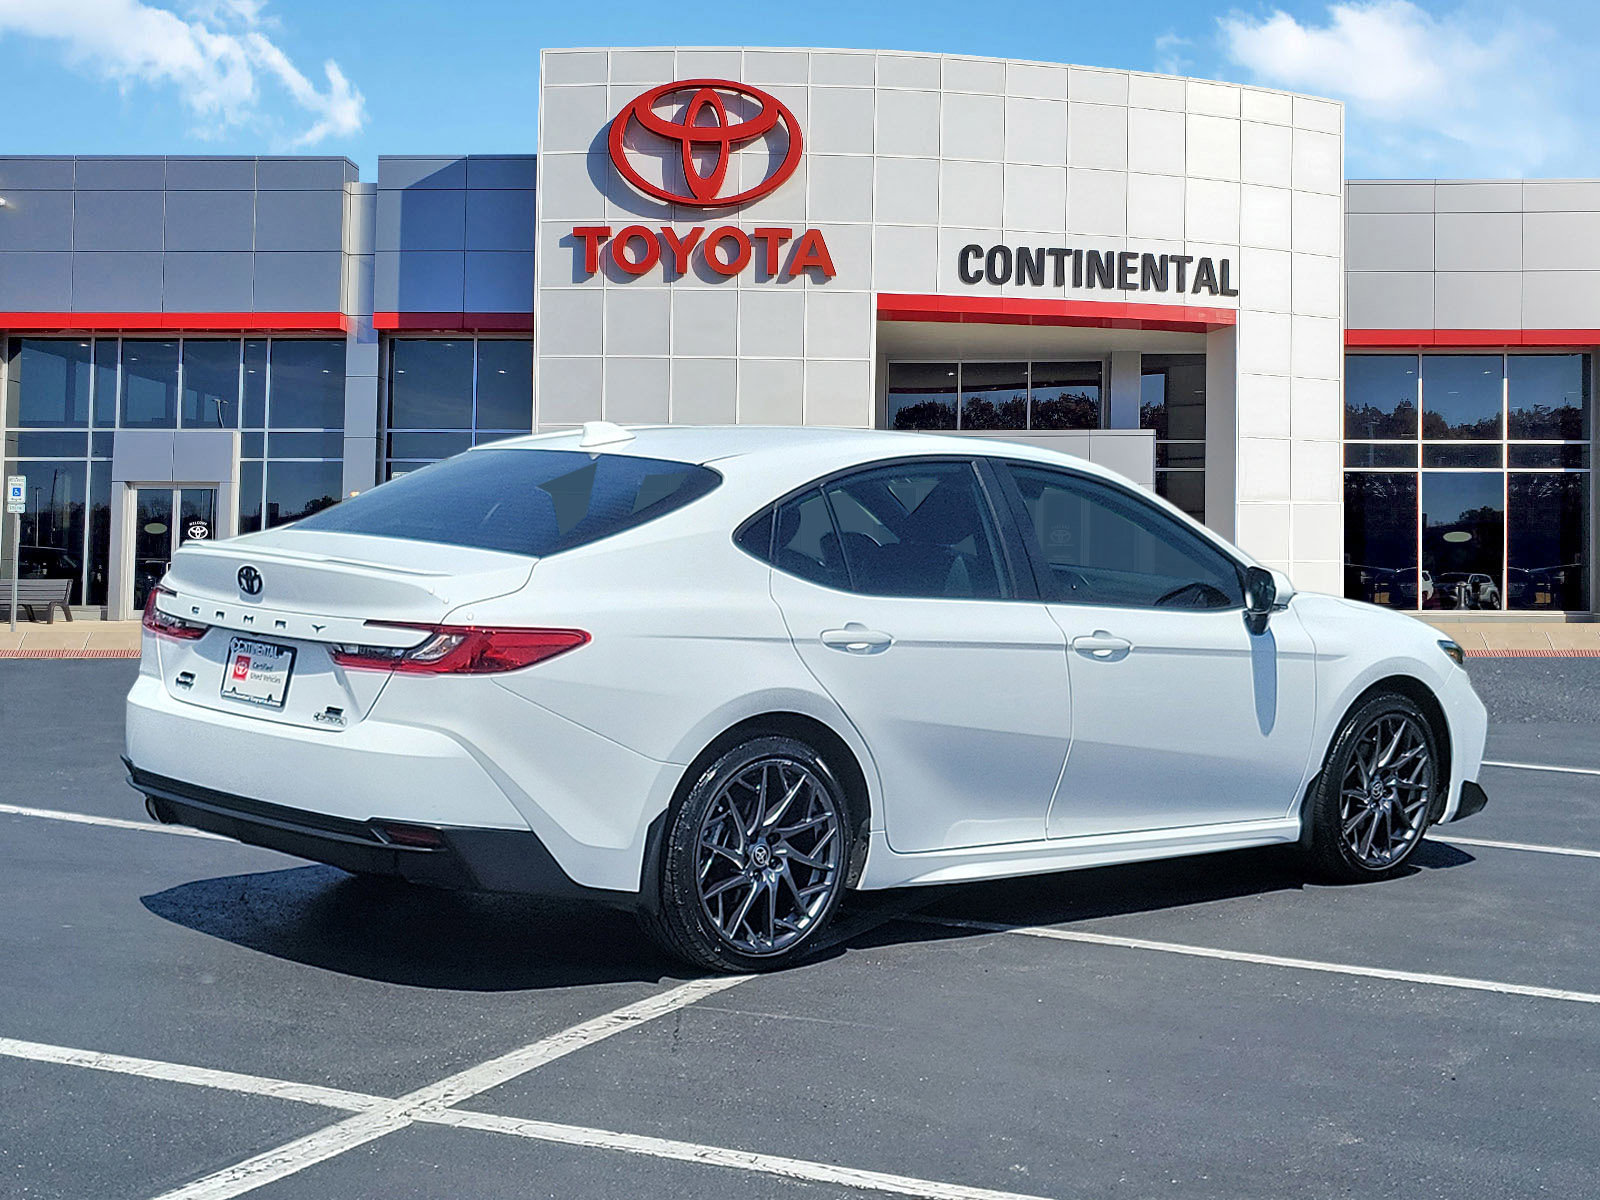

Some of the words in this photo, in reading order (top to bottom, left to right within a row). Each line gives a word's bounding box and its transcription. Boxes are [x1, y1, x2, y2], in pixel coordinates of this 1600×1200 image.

[572, 225, 837, 277] TOYOTA
[958, 244, 1239, 297] CONTINENTAL
[191, 606, 326, 634] CAMRY
[252, 661, 274, 672] Certified
